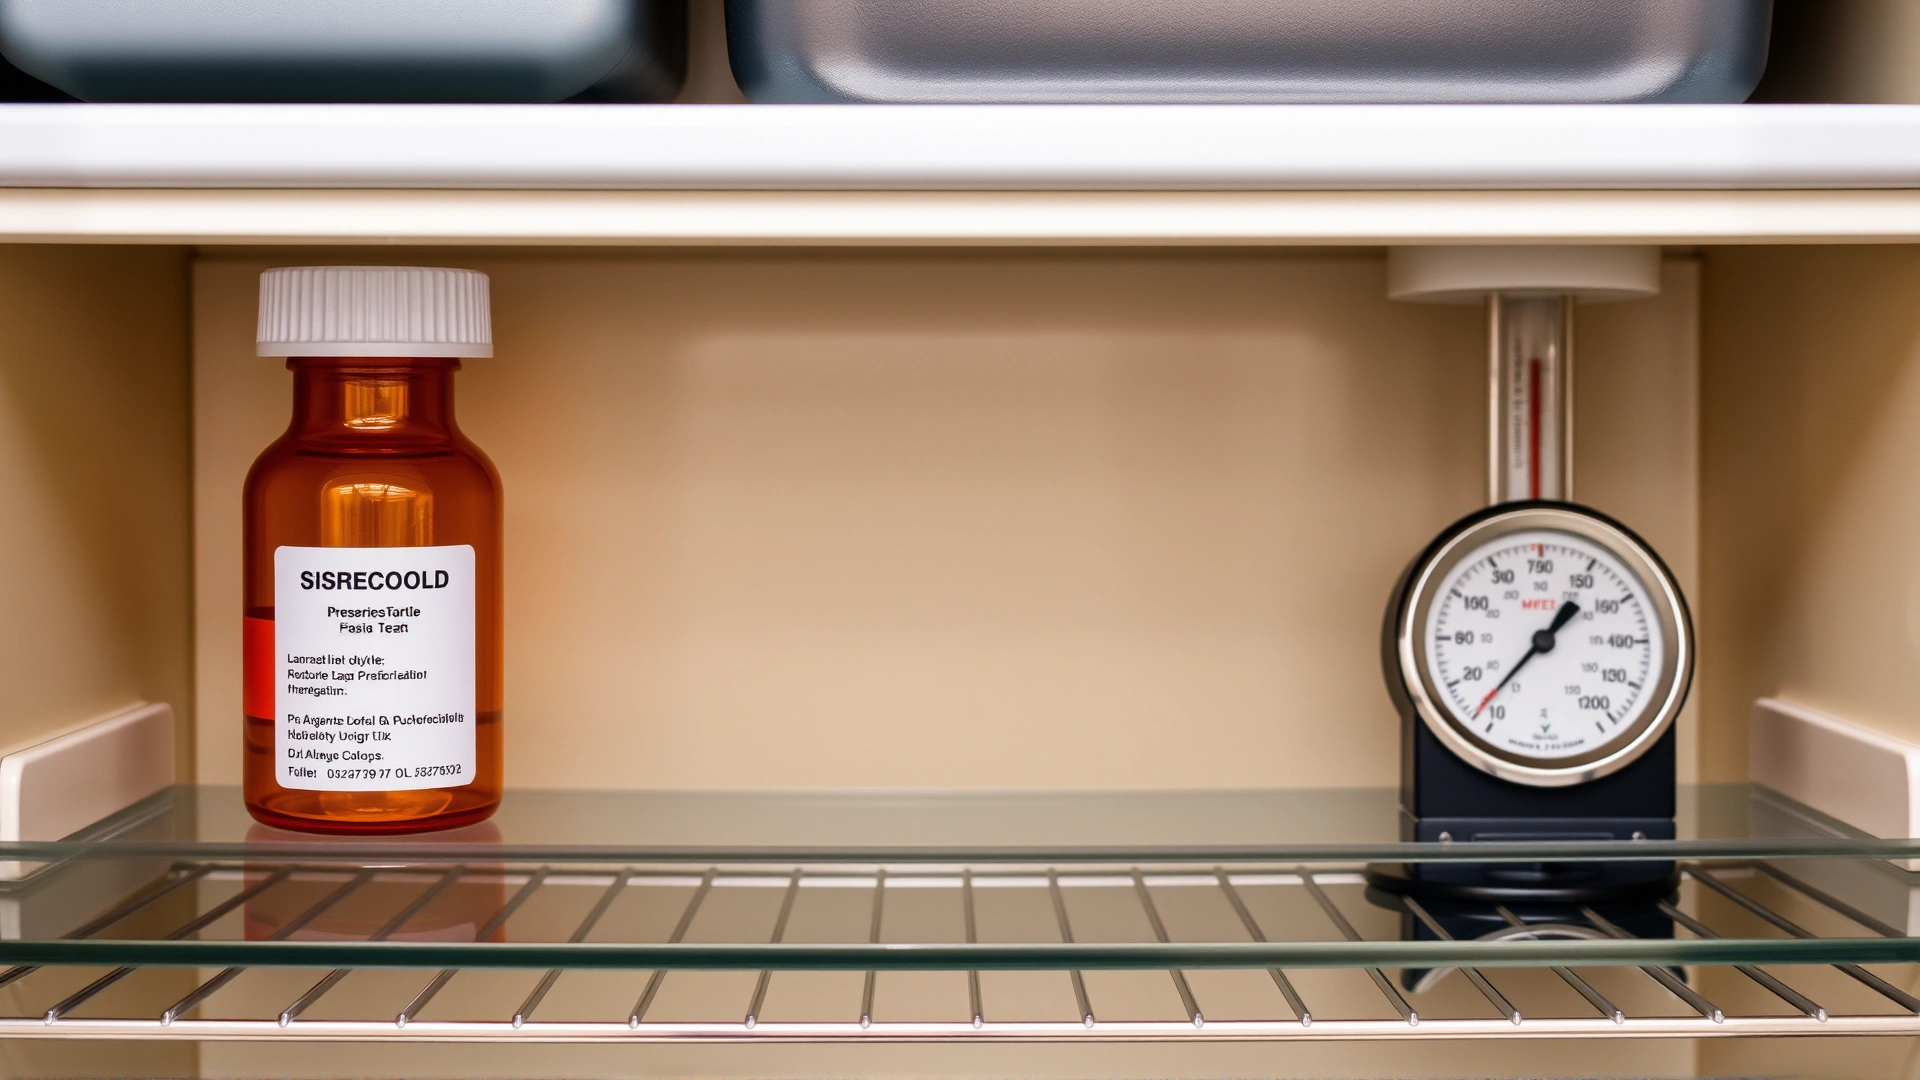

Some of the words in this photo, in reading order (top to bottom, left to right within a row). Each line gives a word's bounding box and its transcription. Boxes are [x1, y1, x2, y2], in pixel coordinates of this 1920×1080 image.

[300, 570, 450, 591] SISRECOOLD
[1463, 666, 1483, 681] 20
[1489, 705, 1506, 721] 10
